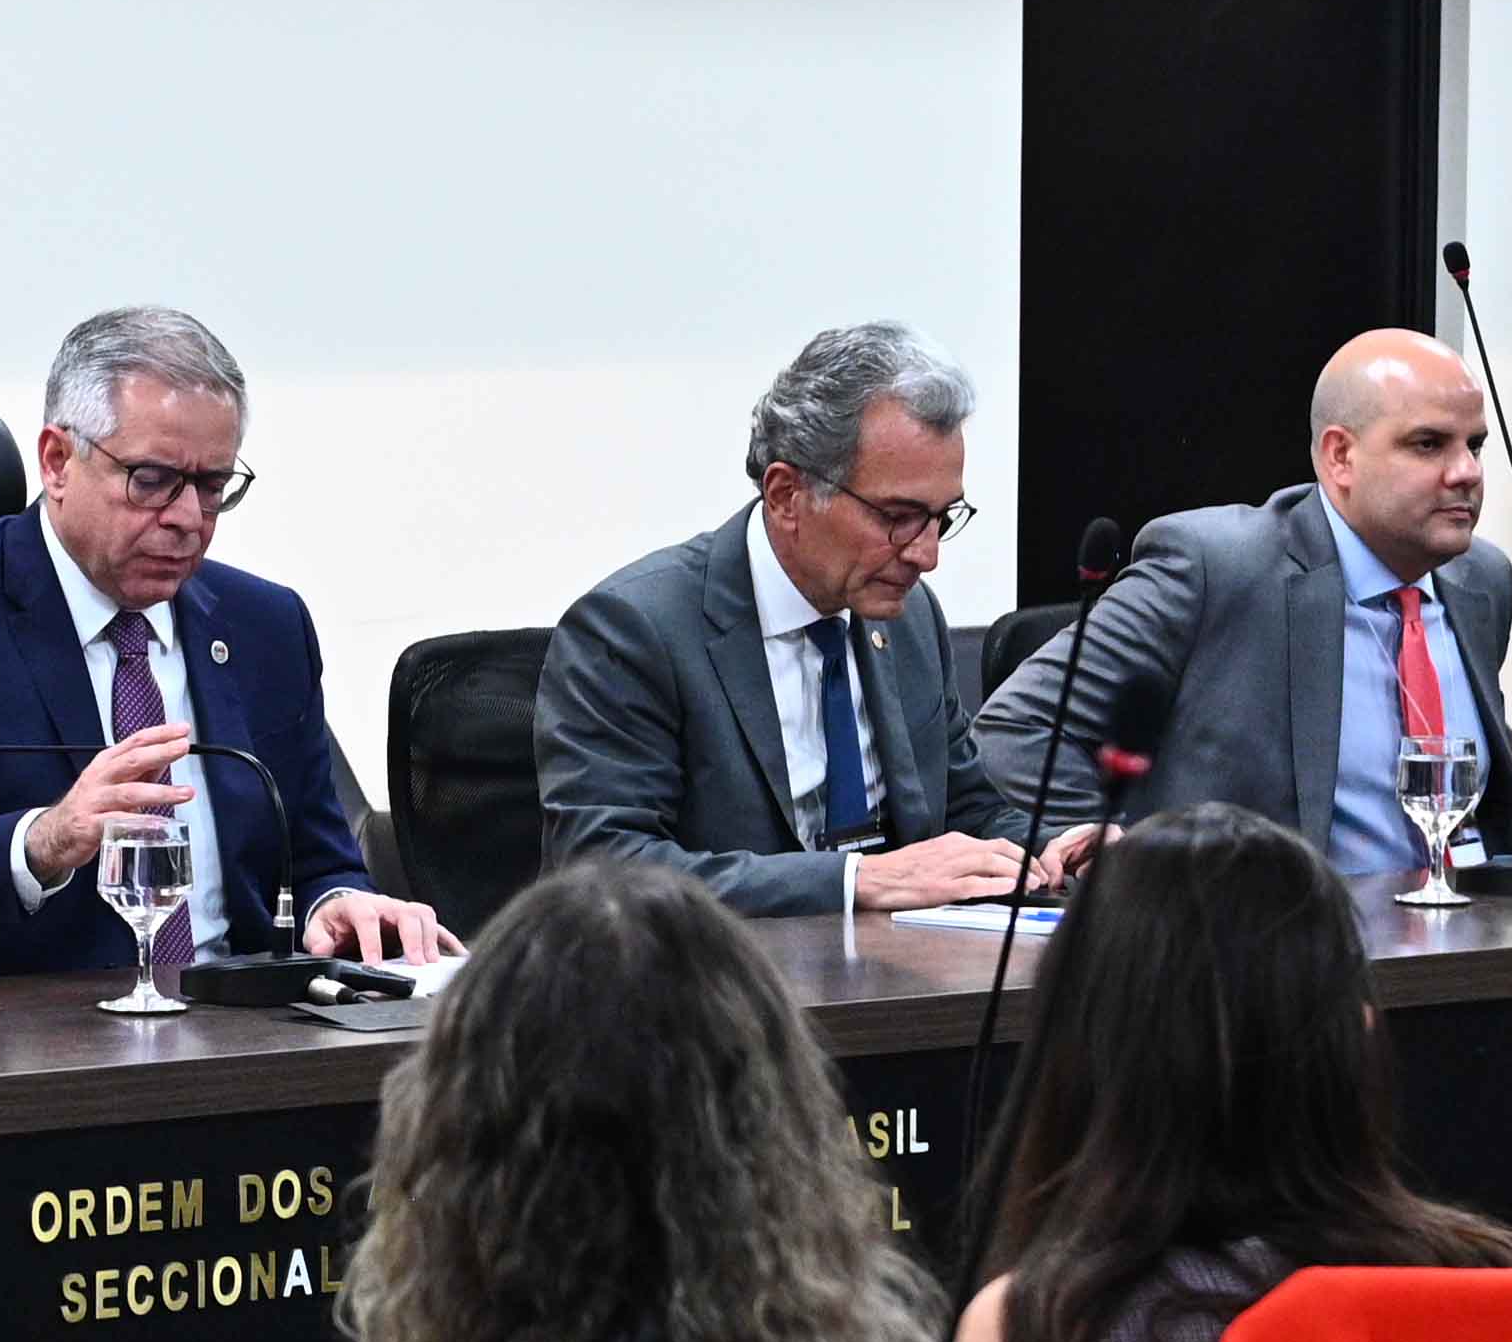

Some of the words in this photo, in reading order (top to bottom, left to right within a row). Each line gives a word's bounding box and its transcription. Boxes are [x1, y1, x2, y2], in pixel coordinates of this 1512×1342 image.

[31, 1178, 204, 1243] ORDEM
[237, 1165, 334, 1224] DOS
[59, 1244, 345, 1324] SECCIONAL
